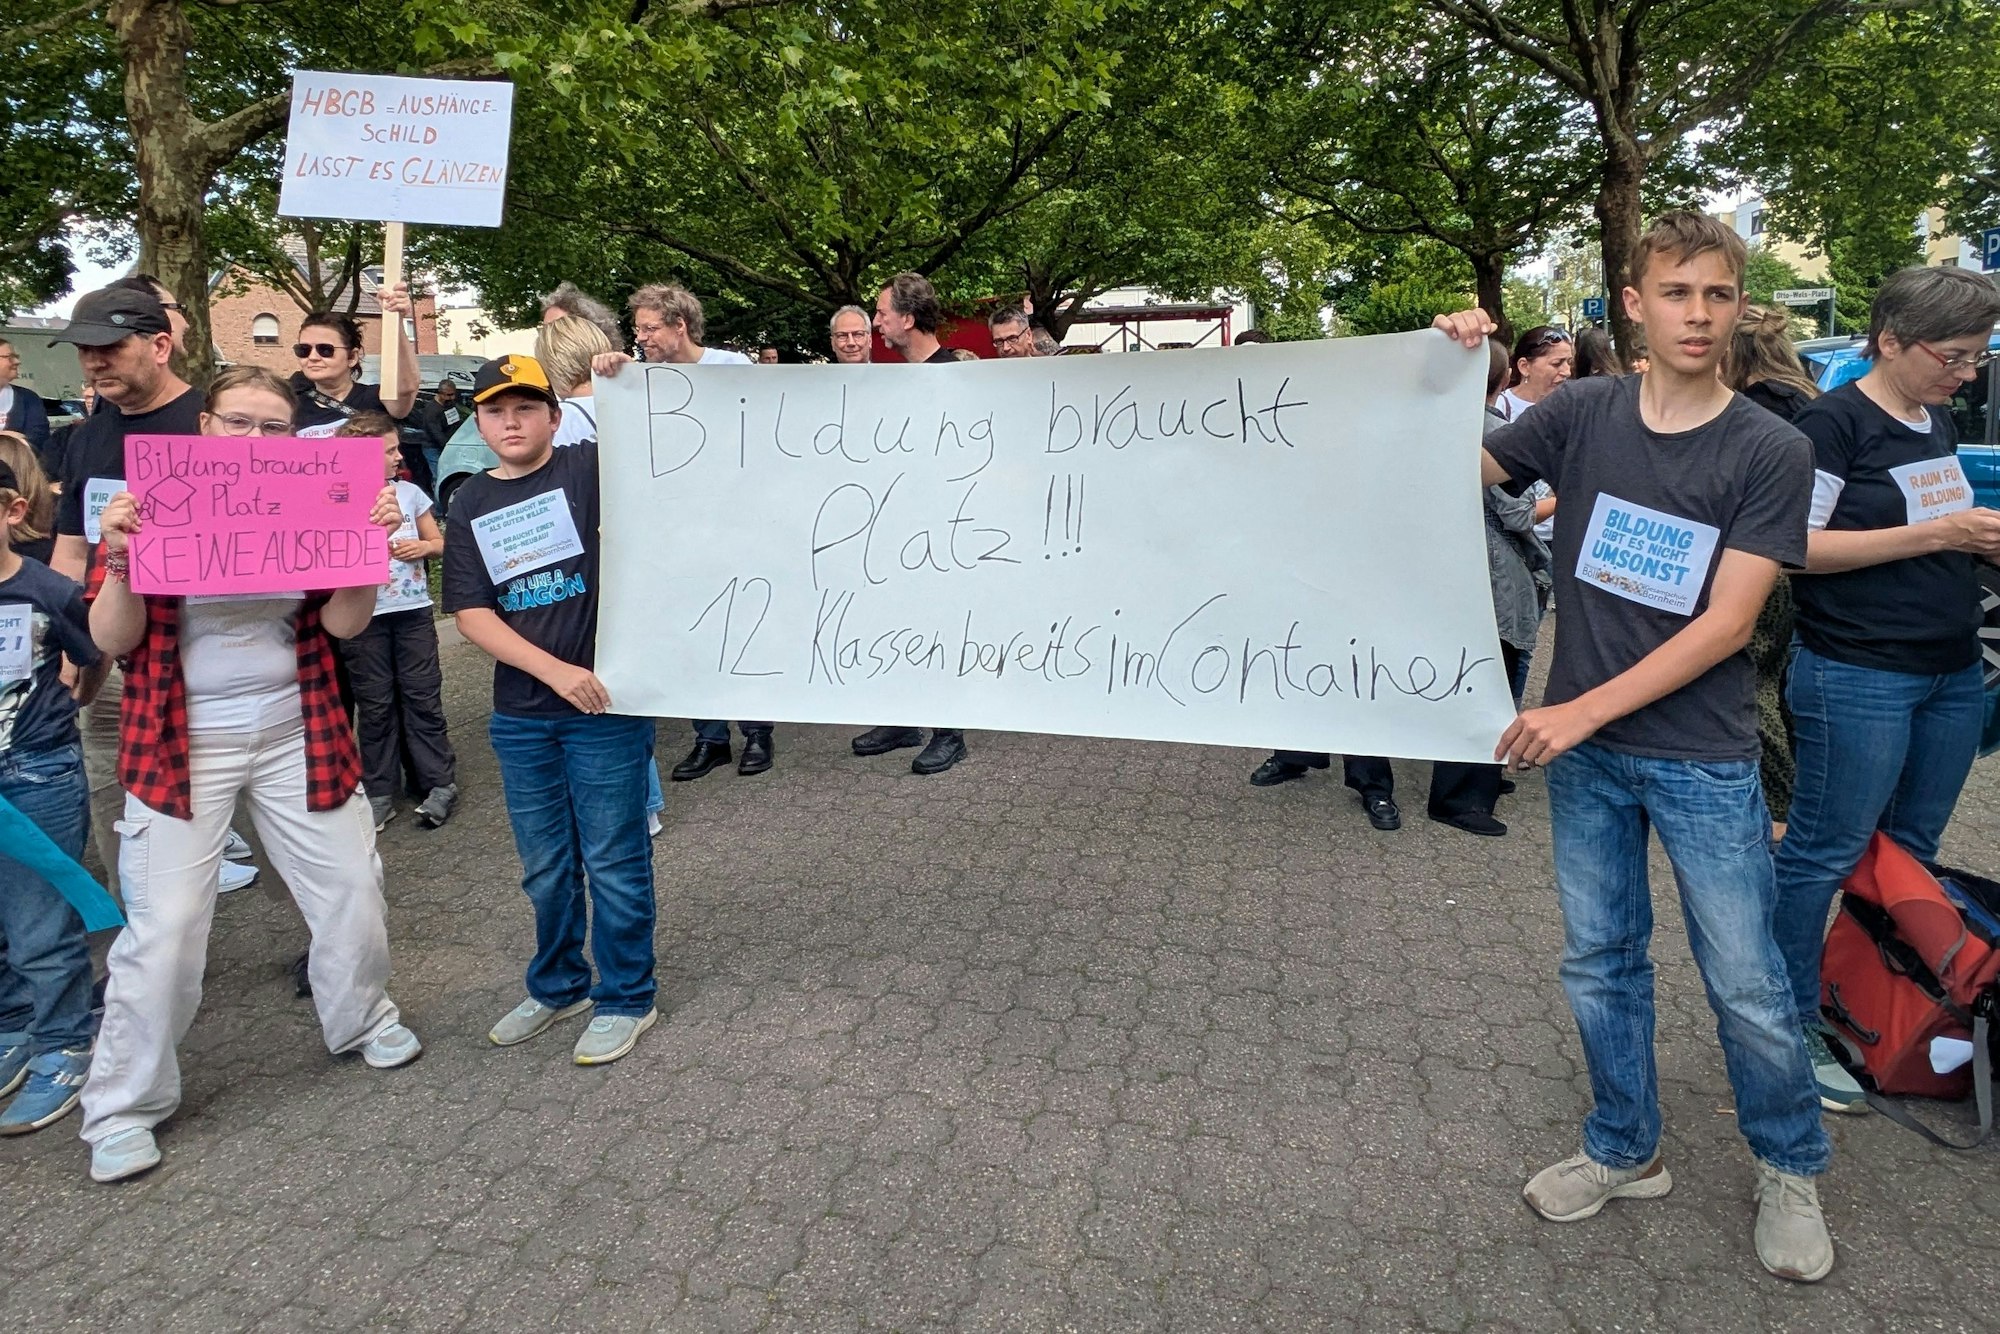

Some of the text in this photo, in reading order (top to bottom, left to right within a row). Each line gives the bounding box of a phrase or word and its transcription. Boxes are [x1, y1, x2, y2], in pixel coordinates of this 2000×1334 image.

[300, 87, 376, 117] HBGB
[296, 152, 503, 186] LASST ES GLÄNZEN
[645, 365, 1309, 482] Bildung braucht
[135, 440, 343, 485] Bildung braucht
[1909, 470, 1943, 490] RAUM
[90, 492, 109, 503] WIR
[90, 505, 107, 516] DE
[212, 483, 281, 517] Platz
[478, 495, 557, 528] BILDUNG BRAUCHT MEHR
[489, 523, 502, 533] ALS
[502, 515, 525, 527] GUTEN
[503, 528, 534, 545] BRAUCHT
[536, 520, 555, 533] EINEN
[1605, 508, 1694, 549] BILDUNG
[260, 528, 382, 575] AUSREDE
[1591, 539, 1691, 586] UMSONST
[1601, 528, 1690, 563] GIBT ES NICHT
[497, 573, 586, 612] DRAGON
[527, 571, 553, 590] LIKE
[554, 568, 565, 584] A
[1642, 590, 1686, 608] Bornheim
[688, 576, 784, 677] 12
